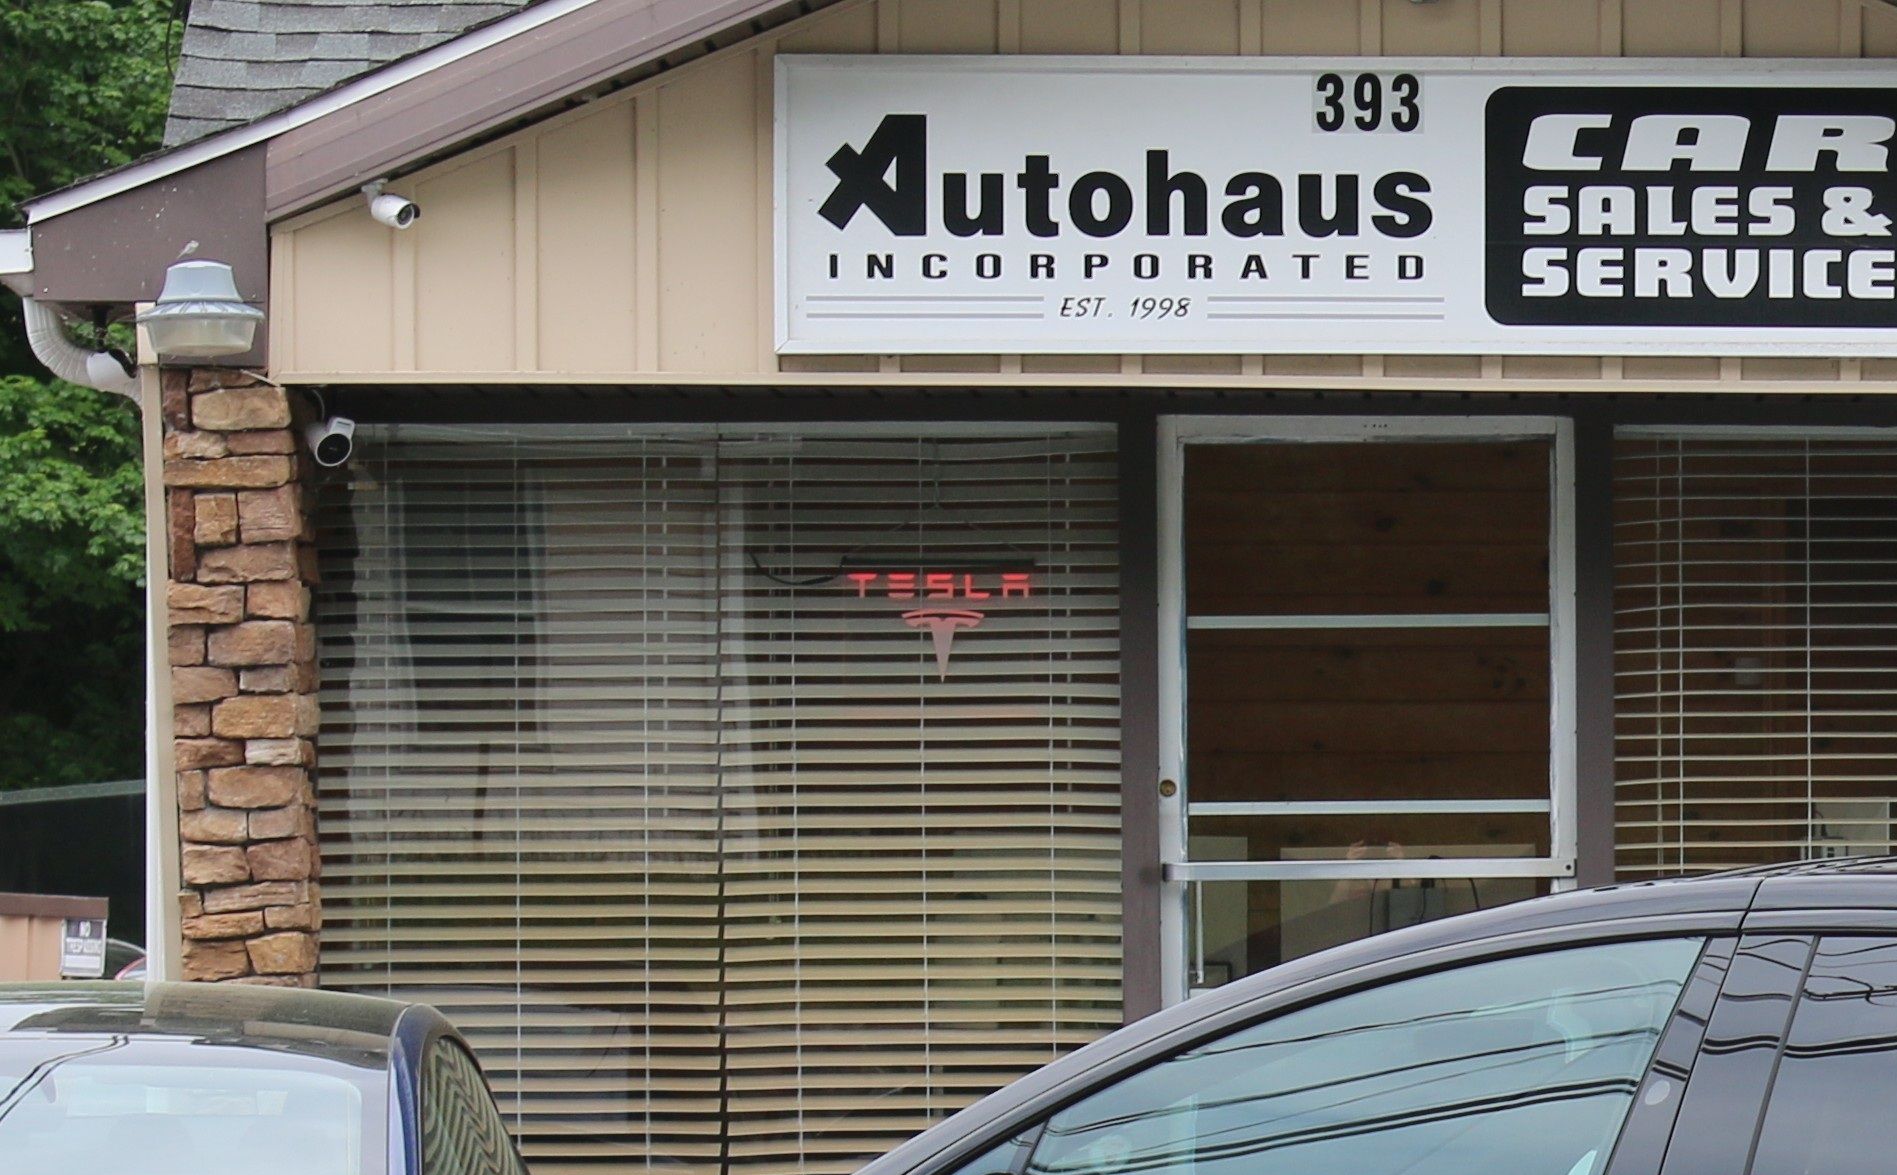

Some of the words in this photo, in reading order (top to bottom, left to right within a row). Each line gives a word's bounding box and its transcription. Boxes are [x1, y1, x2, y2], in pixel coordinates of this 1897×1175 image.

[1317, 72, 1419, 132] 393
[1523, 114, 1895, 171] CAR
[818, 108, 1432, 238] Autohaus
[1524, 186, 1795, 235] SALES
[1822, 187, 1892, 236] &
[830, 254, 1423, 279] INCORPORATED
[1522, 248, 1895, 299] SERVICE
[1060, 297, 1111, 317] EST.
[1131, 298, 1190, 319] 1998
[847, 573, 1031, 599] TESLA
